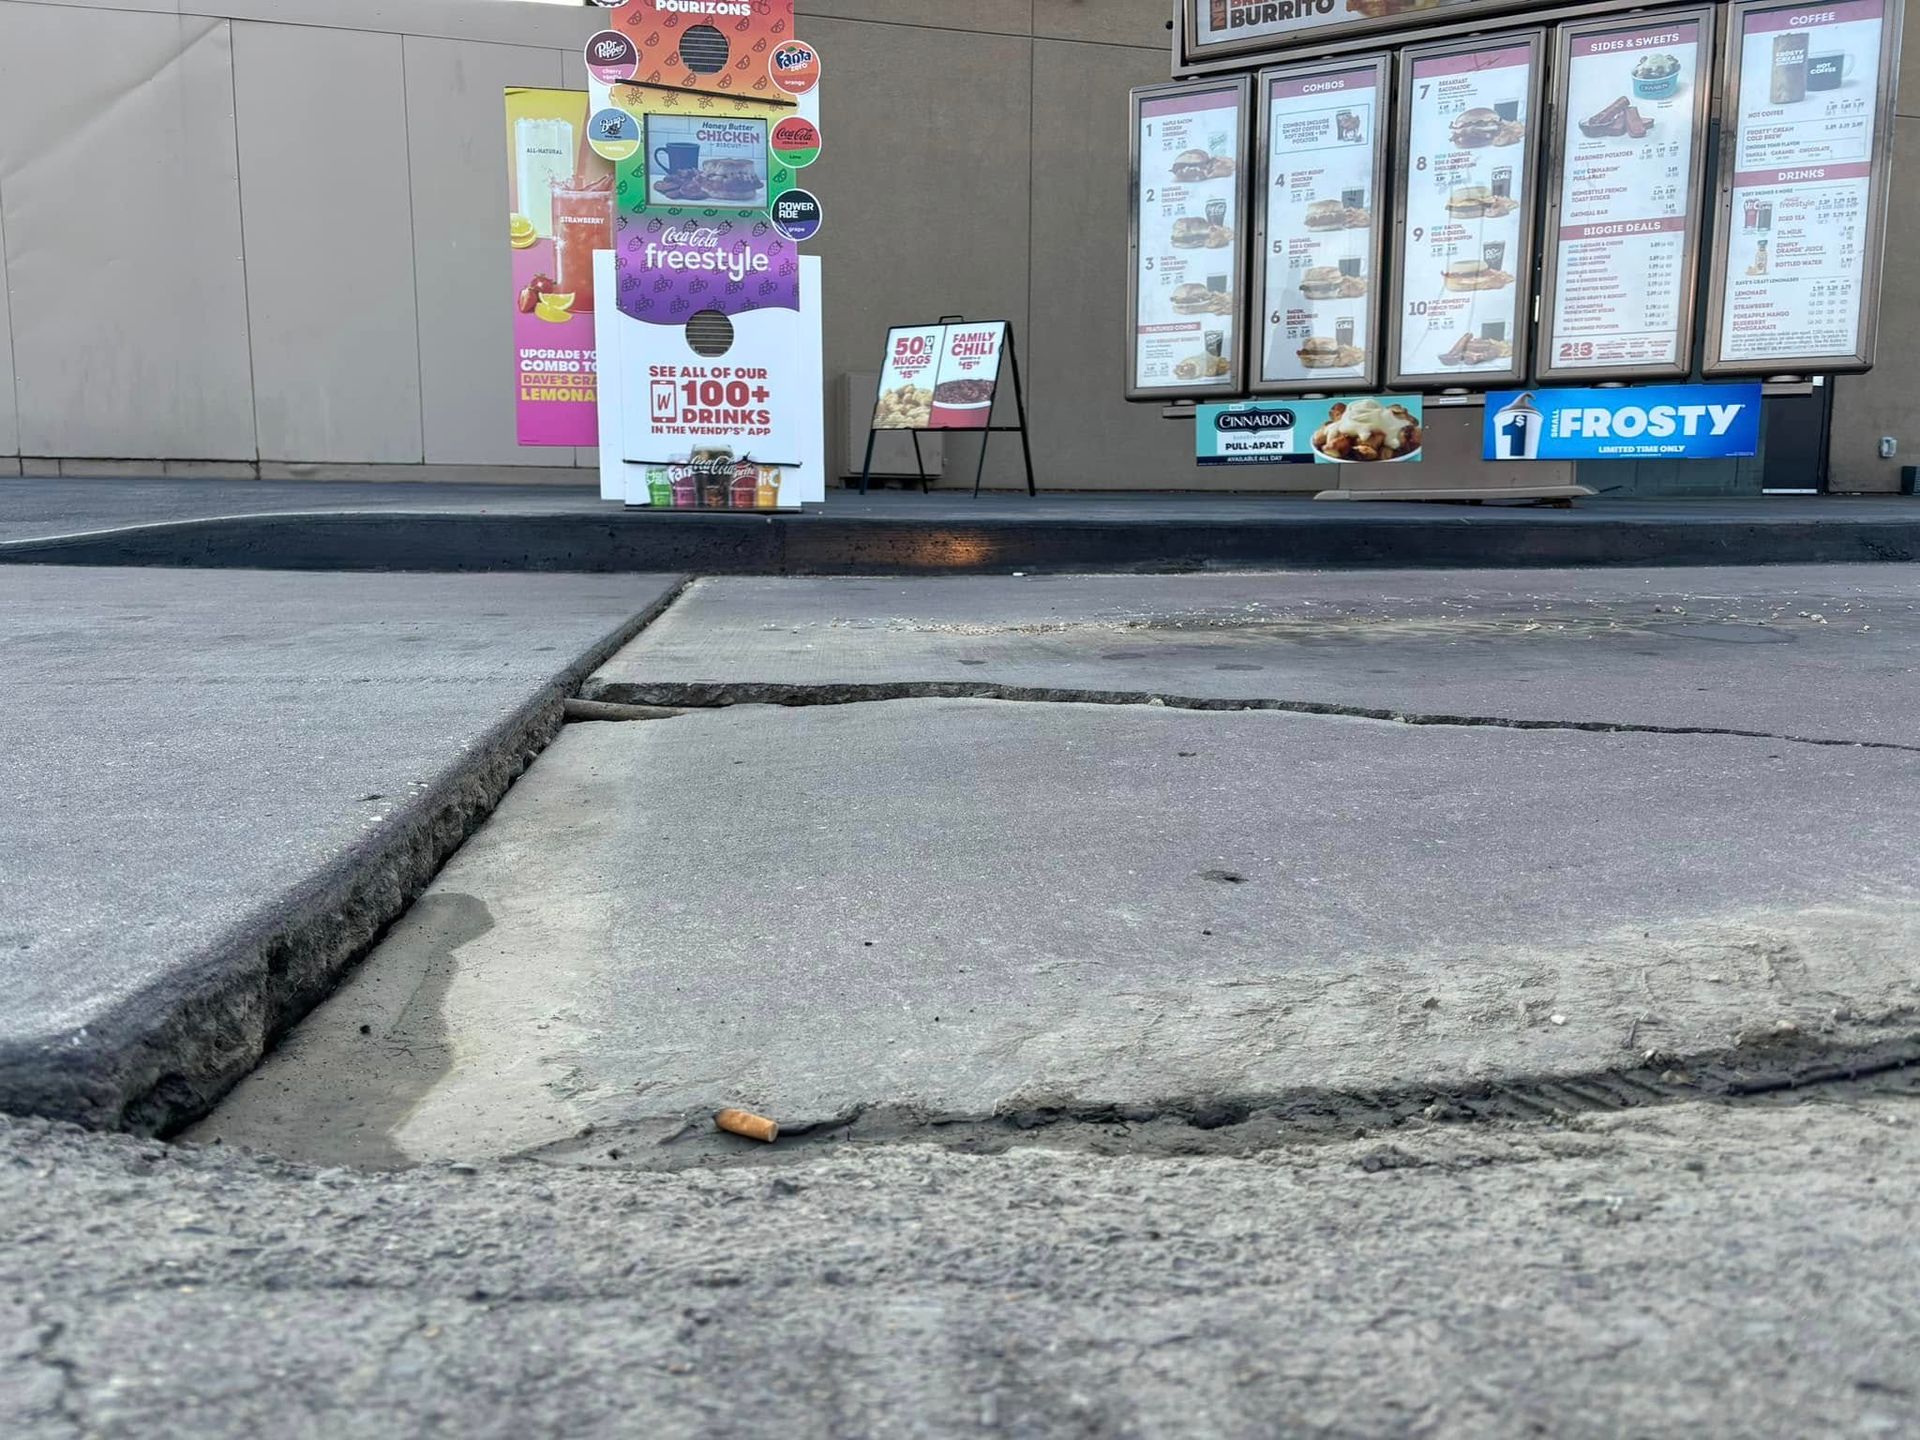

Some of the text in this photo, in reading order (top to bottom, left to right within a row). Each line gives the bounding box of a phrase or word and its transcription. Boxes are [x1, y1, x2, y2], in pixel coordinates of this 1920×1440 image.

[656, 0, 751, 16] POURIZONS
[1230, 0, 1334, 28] BURRITO
[1790, 12, 1836, 25] COFFEE
[1591, 33, 1680, 52] SIDES & SWEETS
[599, 43, 624, 58] Pepper
[774, 49, 813, 70] Fanta
[1302, 80, 1345, 93] COMBOS
[1420, 84, 1431, 100] 7
[702, 121, 754, 132] Honey Butter
[1146, 123, 1152, 137] 1
[696, 130, 760, 144] CHICKEN
[1416, 156, 1427, 171] 8
[1275, 173, 1285, 187] 4
[1778, 169, 1825, 181] DRINKS
[1146, 189, 1155, 203] 2
[779, 202, 814, 211] POWER
[560, 216, 605, 225] STRAWBERRY
[779, 210, 799, 219] ADE
[1413, 227, 1424, 242] 9
[1584, 221, 1661, 236] BIGGIE DEALS
[1273, 240, 1282, 254] 5
[645, 243, 770, 282] freestyle
[1145, 257, 1154, 270] 3
[1408, 301, 1428, 316] 10
[1271, 310, 1280, 324] 6
[953, 331, 996, 343] FAMILY
[895, 336, 924, 355] 50
[951, 342, 994, 356] CHILI
[1560, 342, 1573, 357] 2
[1580, 342, 1593, 356] 3
[520, 349, 580, 359] UPGRADE
[893, 356, 932, 366] NUGGS
[520, 359, 580, 372] COMBO
[649, 365, 767, 379] SEE ALL OF OUR
[523, 374, 569, 385] DAVE'S
[681, 380, 770, 407] 100+
[682, 408, 771, 425] DRINKS
[1219, 413, 1290, 429] CINNABON
[1550, 408, 1560, 438] SMALL
[1560, 404, 1743, 438] FROSTY
[651, 425, 664, 434] IN
[666, 425, 686, 434] THE
[748, 427, 771, 436] APP
[1225, 441, 1285, 451] PULL-APART
